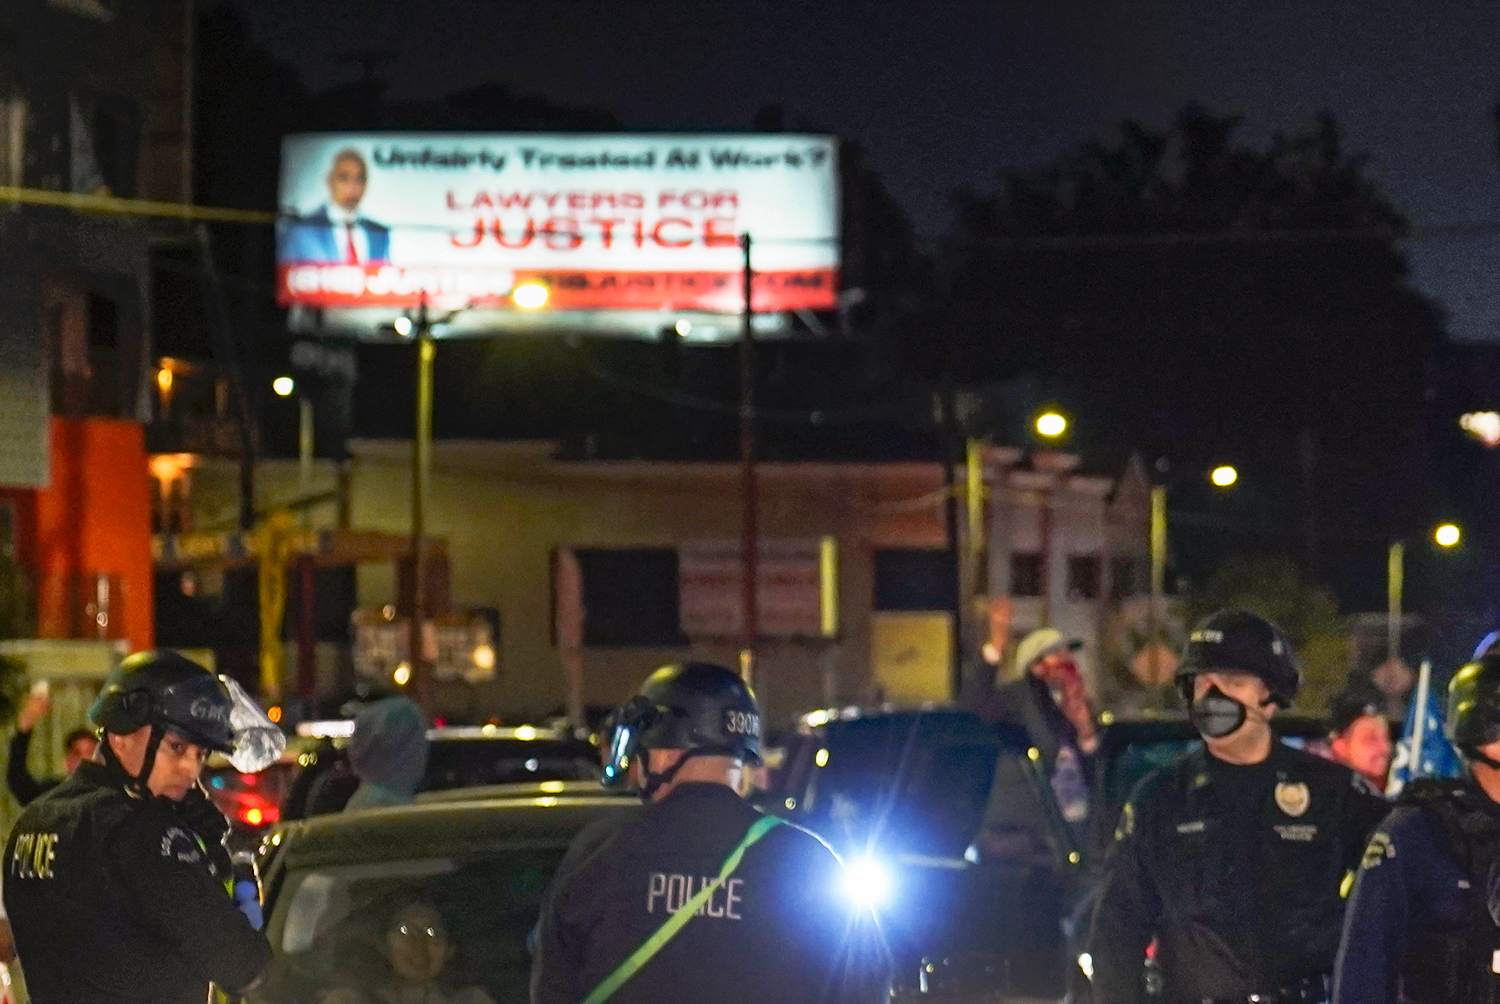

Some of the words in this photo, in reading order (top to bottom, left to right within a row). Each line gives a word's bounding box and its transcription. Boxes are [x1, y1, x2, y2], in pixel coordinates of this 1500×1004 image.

[373, 146, 506, 173] Unfairly
[517, 146, 655, 169] Treated
[663, 147, 701, 170] At
[709, 146, 829, 170] Work?
[445, 188, 645, 211] LAWYERS
[657, 187, 739, 210] FOR
[450, 215, 738, 250] JUSTICE
[11, 833, 60, 879] POLICE
[646, 872, 745, 920] POLICE
